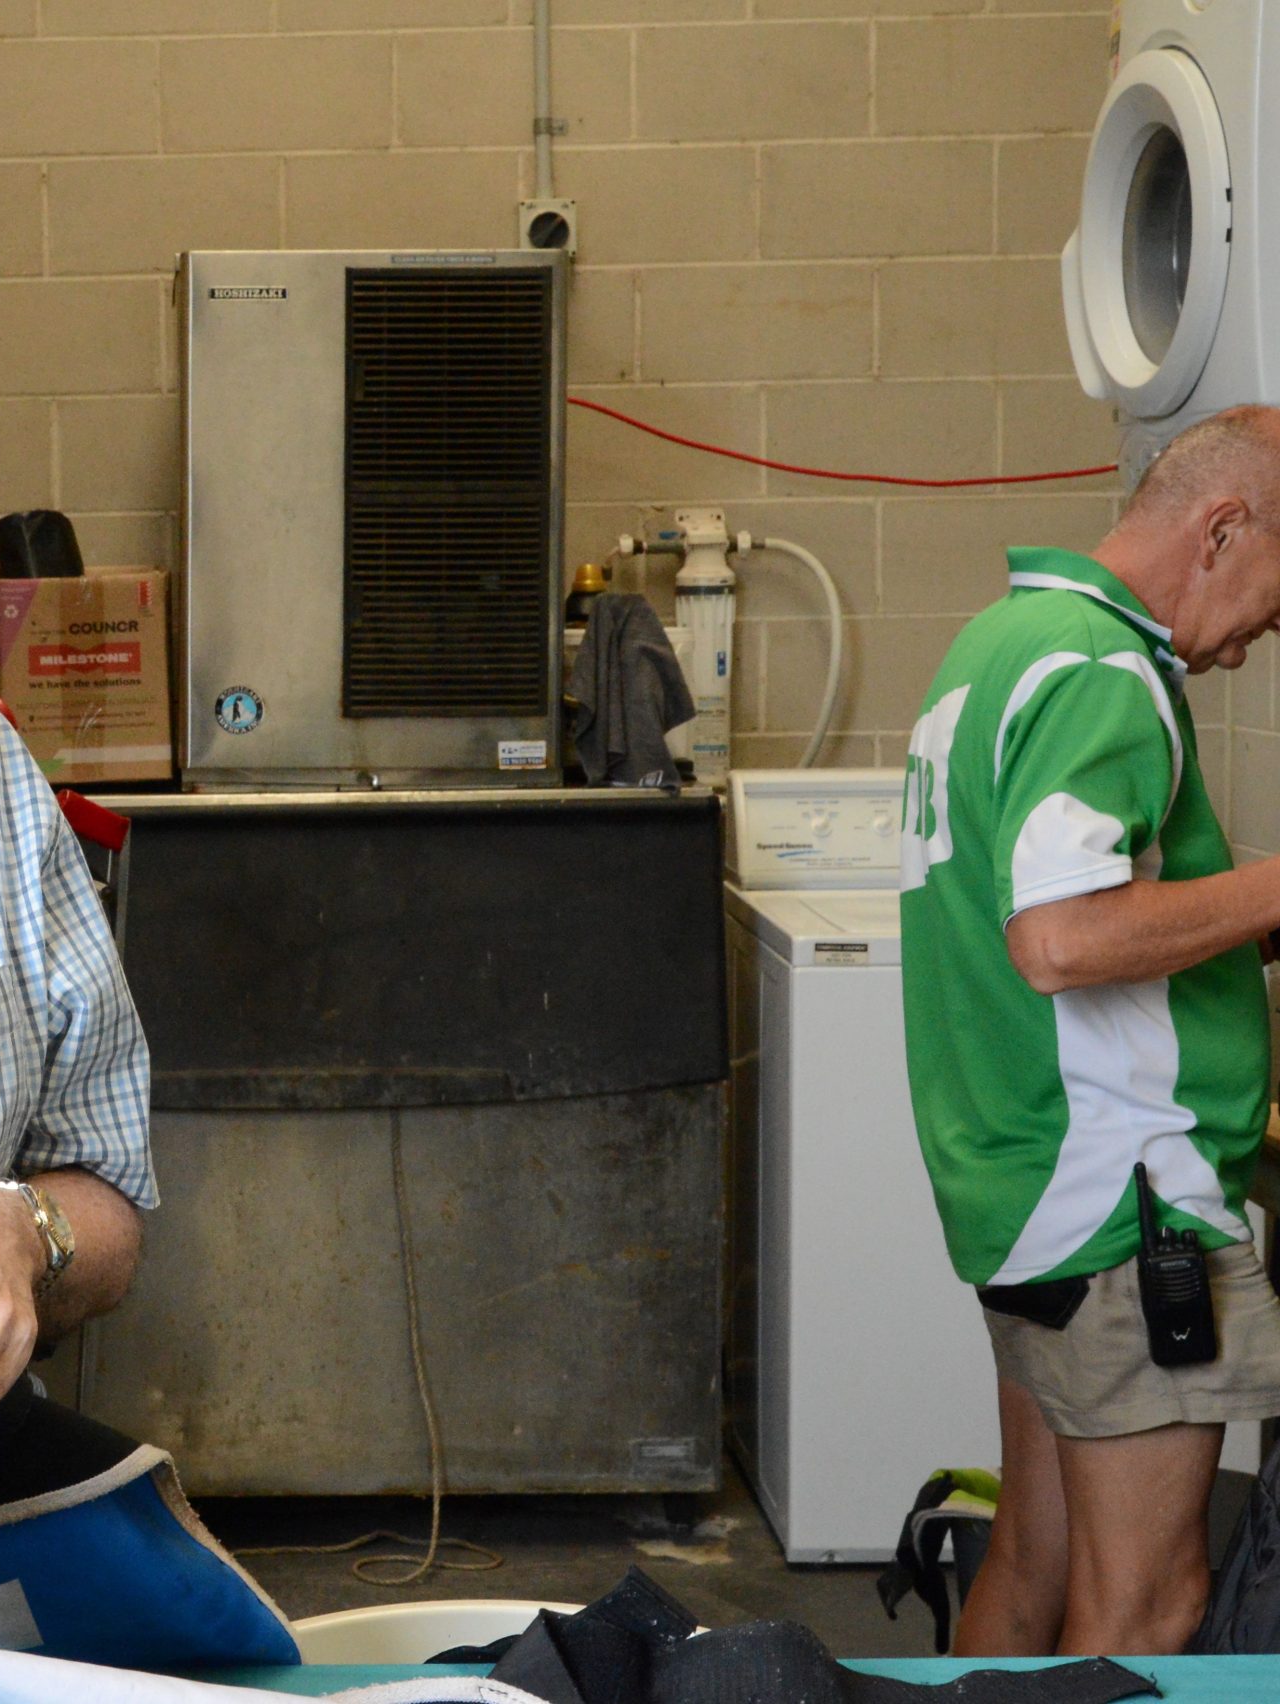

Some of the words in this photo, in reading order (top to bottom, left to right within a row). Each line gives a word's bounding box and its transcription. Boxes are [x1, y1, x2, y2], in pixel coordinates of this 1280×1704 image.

[214, 288, 283, 298] HOSHIZAKI
[40, 653, 129, 665] MILESTONE
[93, 678, 142, 687] solutions
